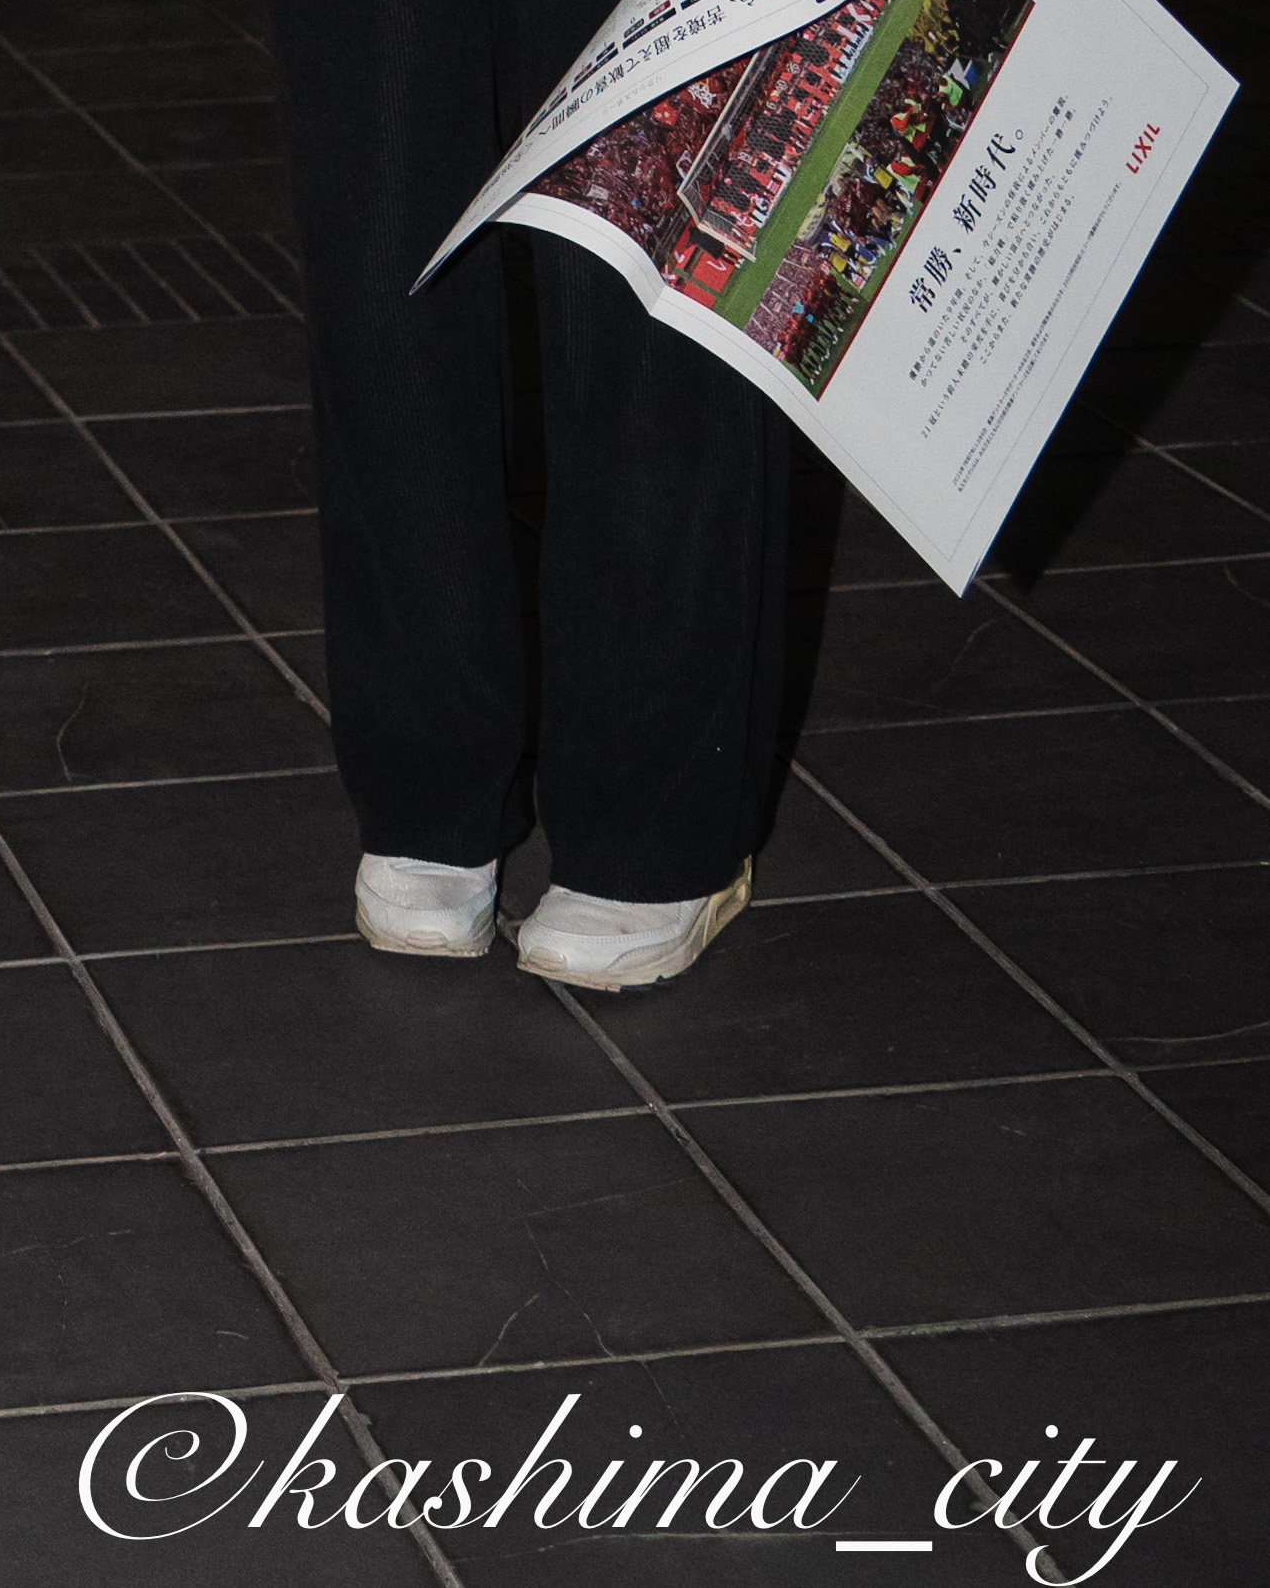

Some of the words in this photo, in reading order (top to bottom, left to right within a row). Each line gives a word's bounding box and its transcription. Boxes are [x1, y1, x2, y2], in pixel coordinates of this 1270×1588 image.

[1124, 122, 1162, 175] LIXIL
[906, 128, 1024, 314] 常勝、新時代。
